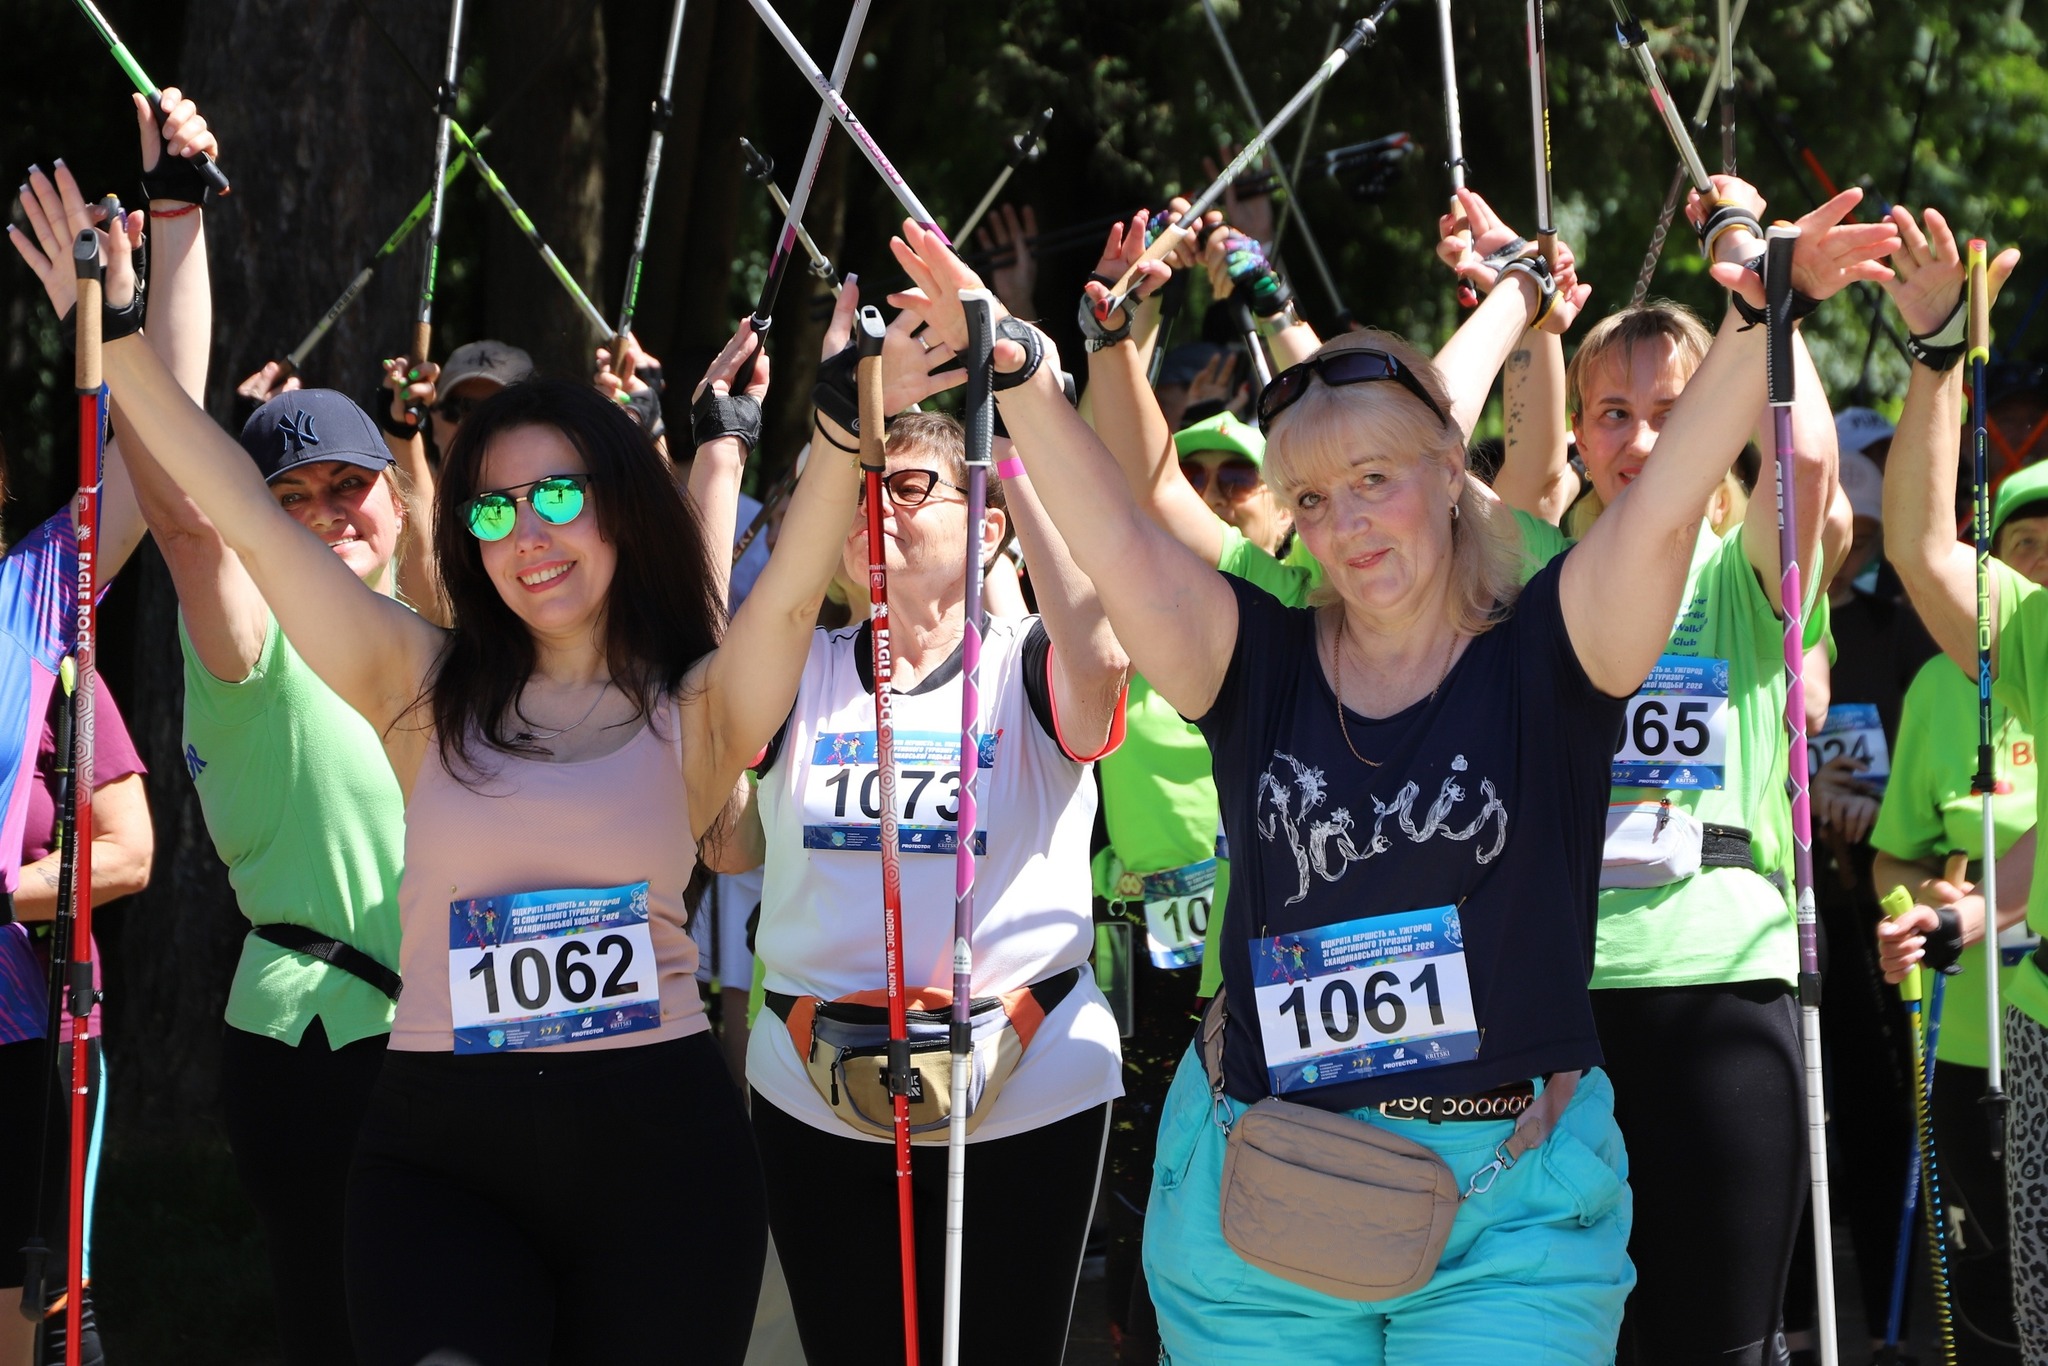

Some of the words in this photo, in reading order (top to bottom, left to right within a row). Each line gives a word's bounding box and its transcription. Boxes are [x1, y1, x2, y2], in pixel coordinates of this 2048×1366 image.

[277, 410, 320, 451] NY
[78, 552, 92, 600] EAGLE
[1978, 551, 1990, 650] VARIO
[77, 605, 91, 652] ROCK
[1673, 637, 1697, 646] Club
[877, 629, 892, 677] EAGLE
[1658, 682, 1684, 690] ХОДЬБИ
[1674, 666, 1704, 676] УЖГОРОД
[1980, 658, 1991, 699] XS
[879, 682, 894, 730] ROCK
[2012, 741, 2037, 766] B
[825, 768, 961, 822] 1073
[511, 905, 544, 917] ВІДКРИТА
[545, 901, 577, 912] ПЕРШІСТЬ
[513, 920, 573, 935] СКАНДИНАВСЬКОЇ
[574, 915, 600, 926] ХОДЬБИ
[521, 911, 568, 925] СПОРТИВНОГО
[568, 907, 600, 918] ТУРИЗМУ
[885, 908, 896, 949] NORDIC
[1320, 935, 1352, 950] ВІДКРИТА
[1352, 930, 1387, 944] ПЕРШІСТЬ
[1399, 923, 1433, 936] УЖГОРОД
[1322, 950, 1330, 959] ЗІ
[1330, 941, 1377, 957] СПОРТИВНОГО
[1378, 936, 1413, 948] ТУРИЗМУ
[1323, 951, 1383, 968] СКАНДИНАВСЬКОЇ
[1383, 945, 1414, 957] ХОДЬБИ
[469, 933, 639, 1015] 1062
[887, 951, 897, 999] WALKING
[1279, 963, 1446, 1050] 1061
[571, 1027, 605, 1039] PROTECTOR
[609, 1019, 633, 1030] KRITSKI
[1383, 1058, 1419, 1071] PROTECTOR
[1424, 1050, 1451, 1061] KRITSKI
